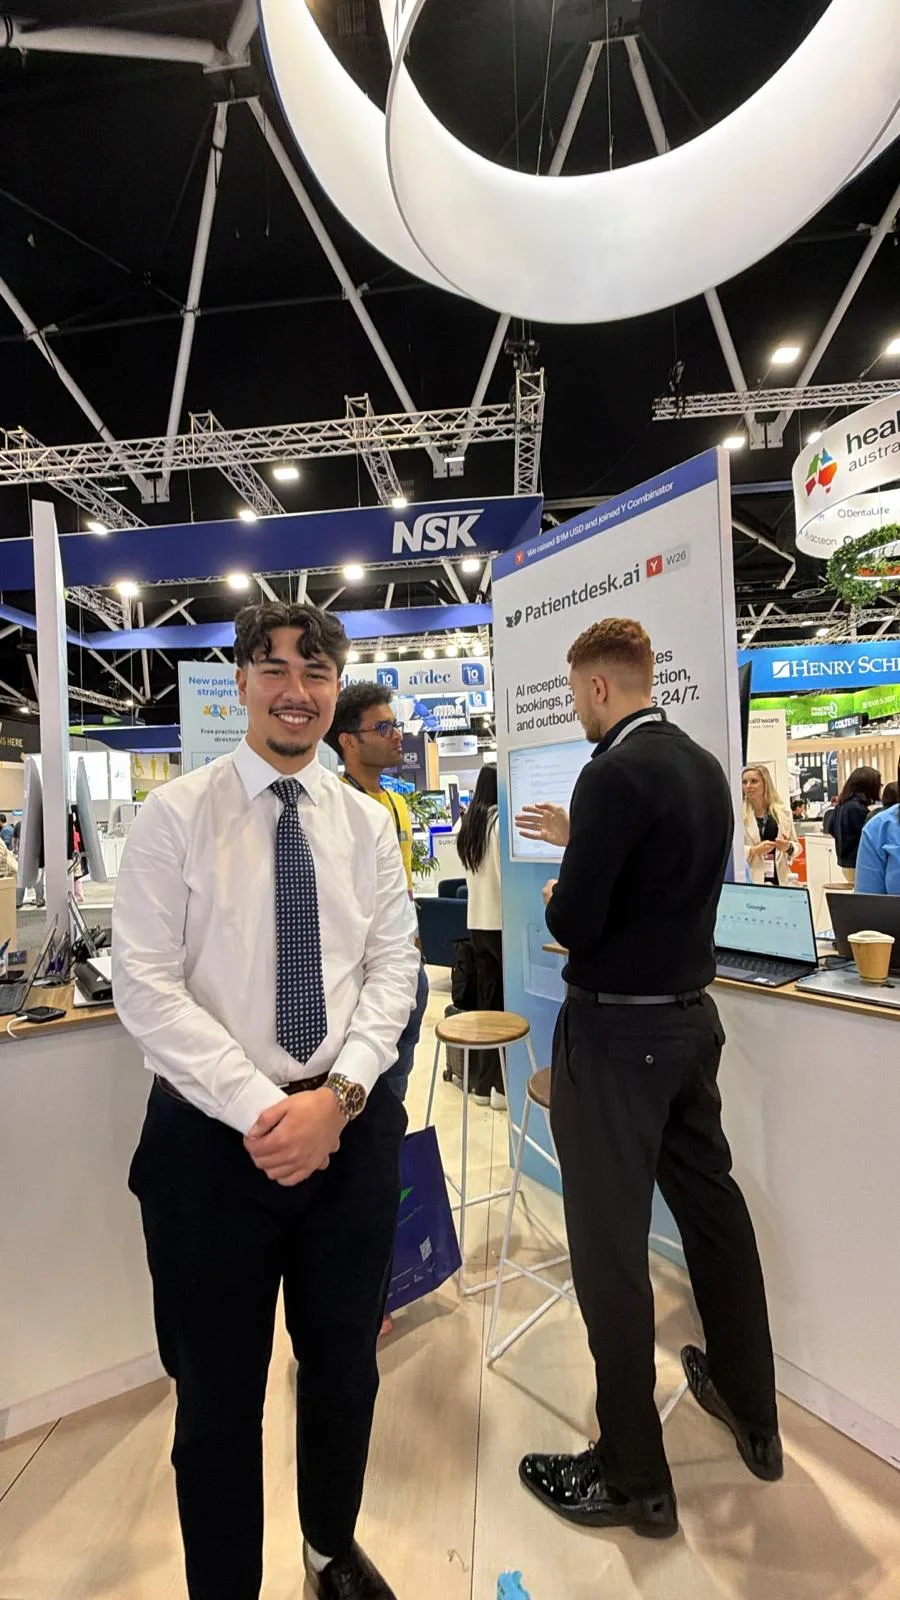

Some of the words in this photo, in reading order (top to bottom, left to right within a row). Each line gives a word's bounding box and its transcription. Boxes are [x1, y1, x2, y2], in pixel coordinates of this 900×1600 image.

[527, 548, 537, 557] We
[556, 531, 569, 544] $1M
[570, 524, 584, 537] USD
[585, 518, 598, 530] and
[599, 507, 621, 526] joined
[621, 503, 627, 512] Y
[628, 482, 674, 510] Combinator
[846, 507, 890, 517] DentaLife
[392, 508, 485, 554] NSK
[524, 563, 641, 623] Patientdesk.ai
[666, 550, 687, 566] W26
[652, 650, 673, 665] es
[791, 660, 855, 678] HENRY
[188, 676, 210, 685] New
[516, 684, 525, 698] AI
[526, 674, 570, 695] receptio
[197, 689, 233, 698] straight
[661, 684, 700, 706] 24/7.
[516, 696, 564, 715] bookings,
[516, 716, 535, 732] and
[7, 737, 24, 748] HERE
[746, 903, 767, 912] Google
